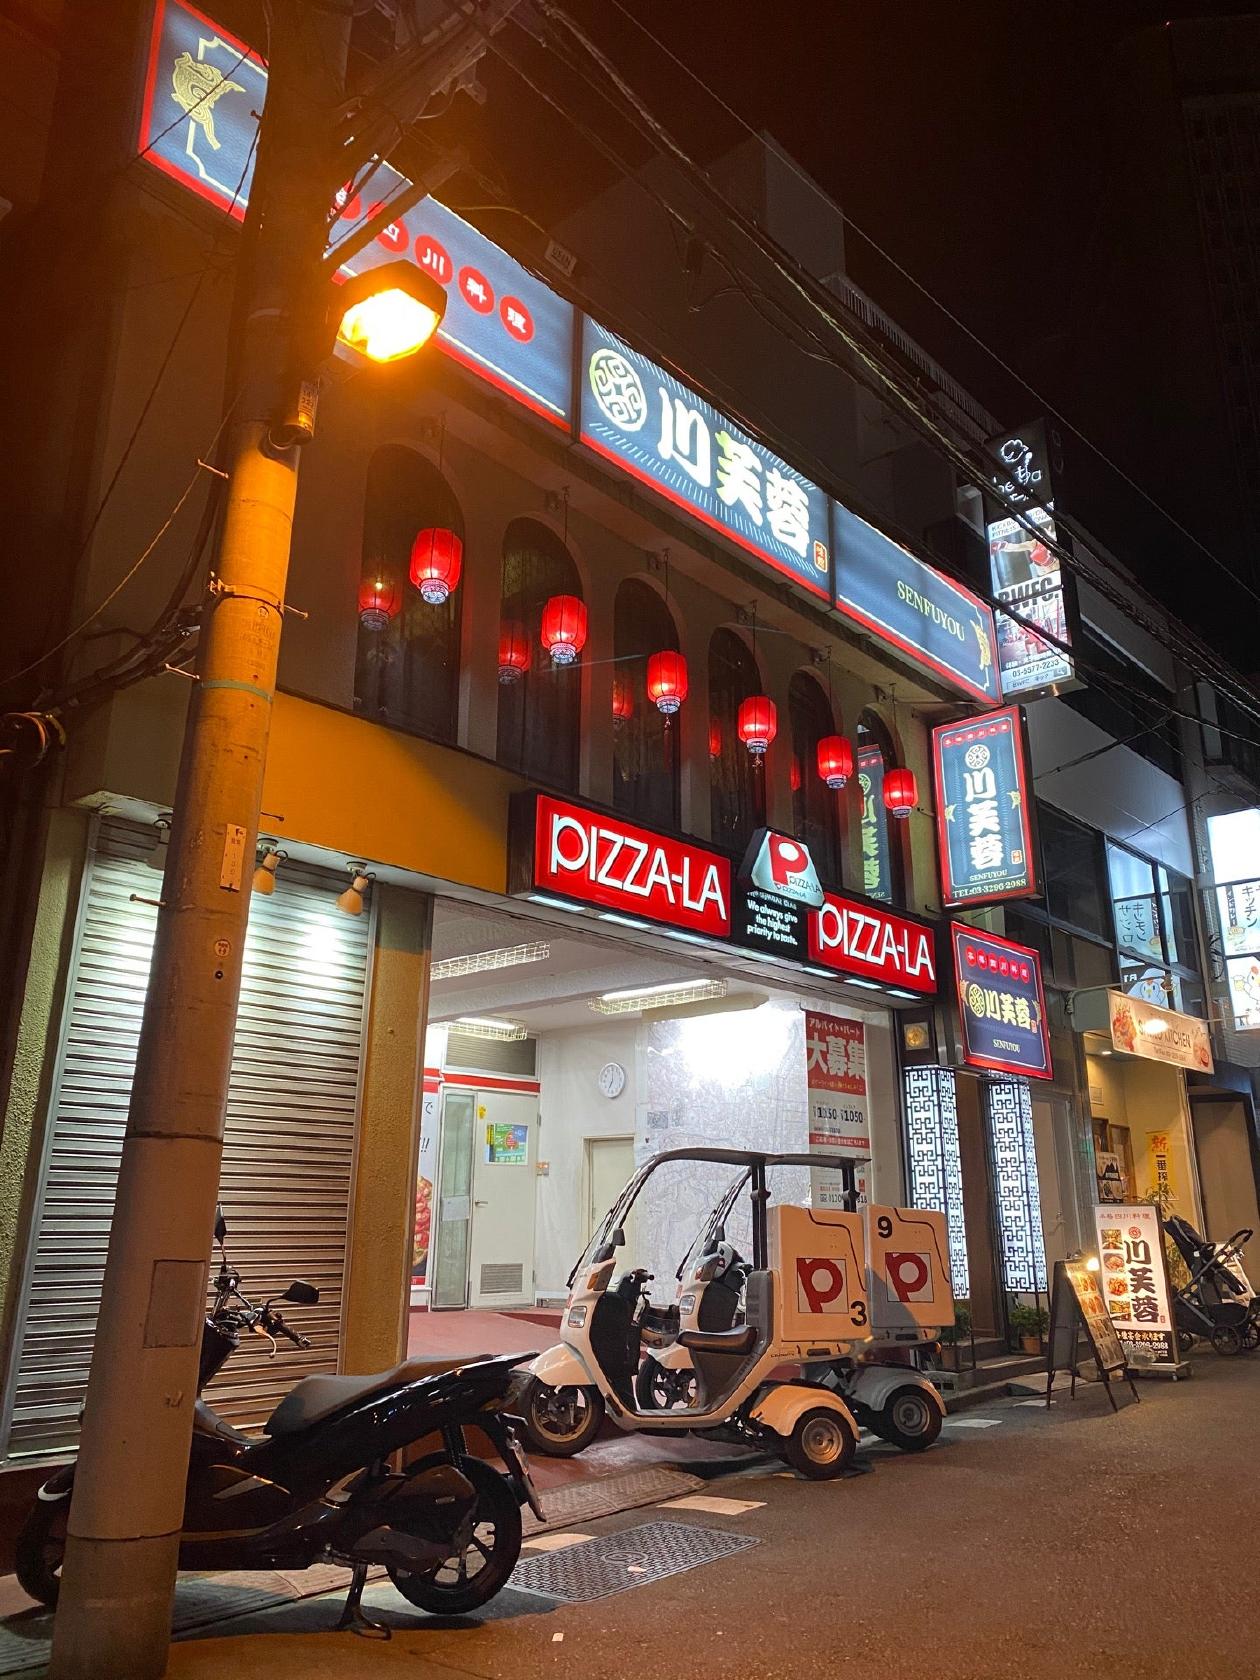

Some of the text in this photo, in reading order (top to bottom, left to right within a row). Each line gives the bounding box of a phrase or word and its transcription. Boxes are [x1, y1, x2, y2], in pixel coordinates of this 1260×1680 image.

[896, 580, 965, 641] SENFUYOU
[963, 766, 1005, 871] 川芙蓉
[550, 813, 728, 921] PIZZA-LA
[969, 869, 1008, 882] SENFUYOU
[747, 899, 760, 911] We
[760, 904, 783, 920] always
[784, 912, 798, 923] give
[756, 914, 791, 932] the highest
[1241, 885, 1258, 928] キッチン
[747, 924, 772, 941] priority
[818, 903, 936, 981] PIZZA-LA
[984, 988, 1031, 1030] 川芙蓉
[807, 1032, 865, 1080] 大募集
[877, 1215, 893, 1239] 9
[1123, 1239, 1160, 1324] 川芙蓉
[850, 1300, 868, 1327] 3
